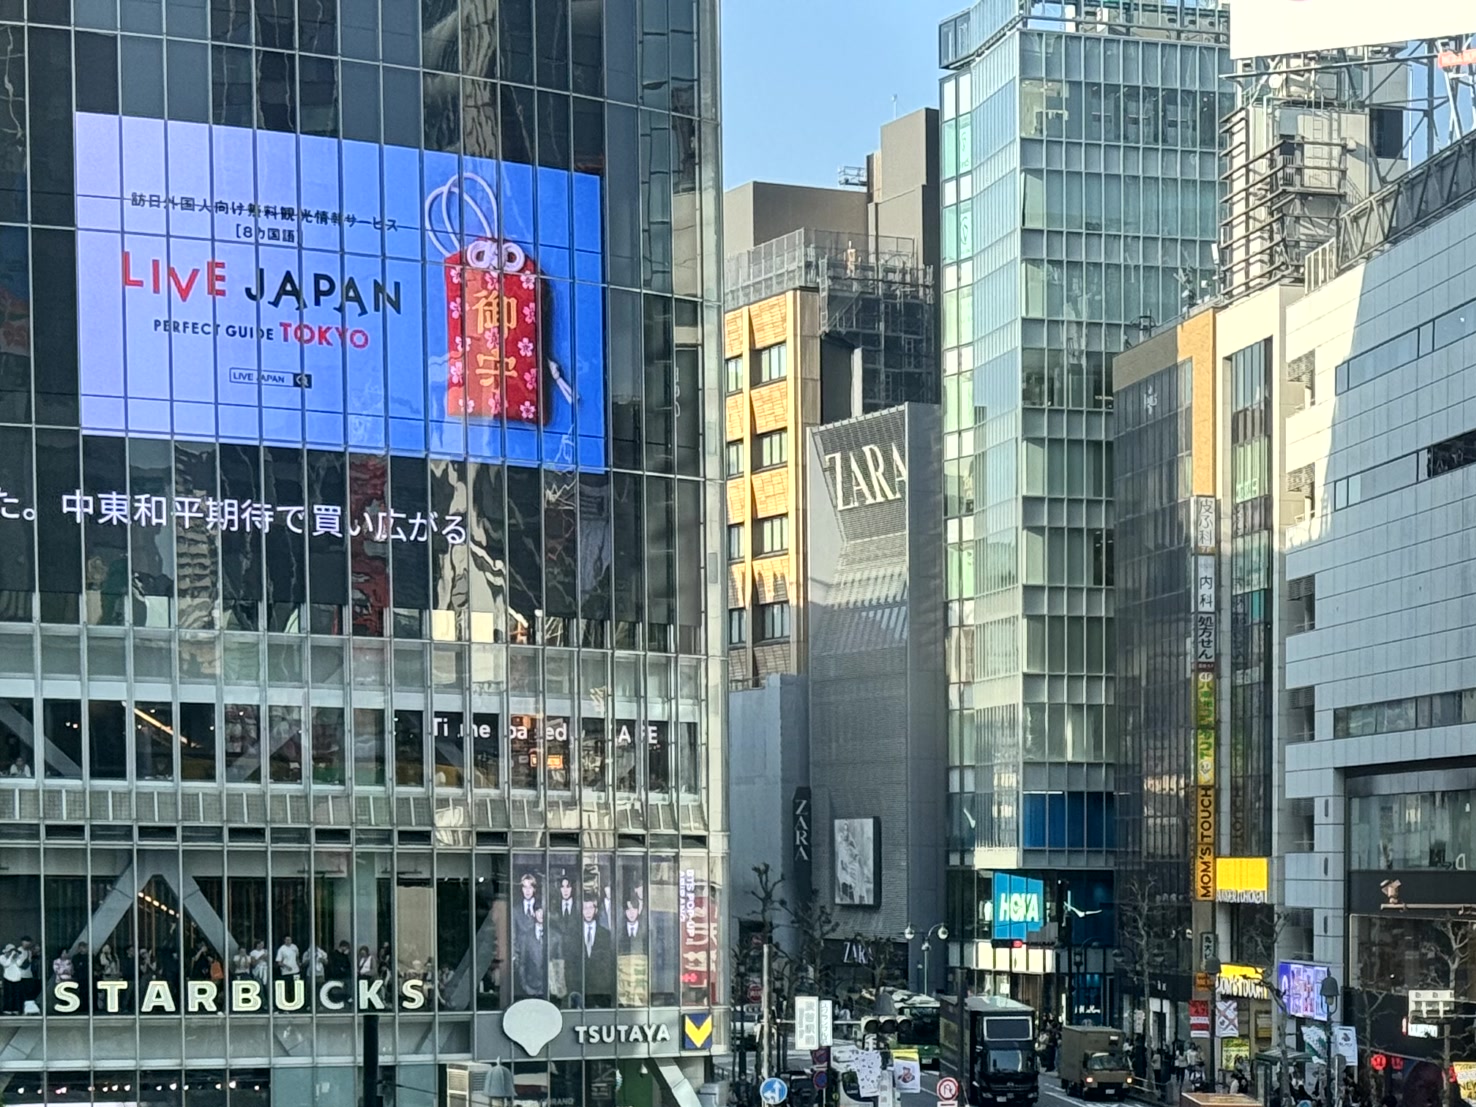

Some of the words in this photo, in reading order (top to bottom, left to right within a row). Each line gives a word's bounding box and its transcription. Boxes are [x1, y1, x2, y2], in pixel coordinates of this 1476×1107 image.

[122, 251, 227, 303] LIVE
[244, 267, 402, 318] JAPAN
[154, 319, 220, 338] PERFECT
[225, 324, 275, 342] GUIDE
[279, 322, 370, 349] TOKYO
[232, 371, 254, 382] LIVE
[825, 442, 907, 511] ZARA
[61, 489, 468, 546] 中東和平期待で買い広がる
[1199, 575, 1214, 608] 内科
[1198, 615, 1214, 660] 処方せん
[793, 799, 810, 861] ZARA
[1200, 786, 1213, 843] TOUCH
[1200, 845, 1213, 898] MOM'S
[998, 892, 1040, 923] HOKA
[53, 979, 426, 1014] STARBUCKS
[574, 1024, 671, 1045] TSUTAYA
